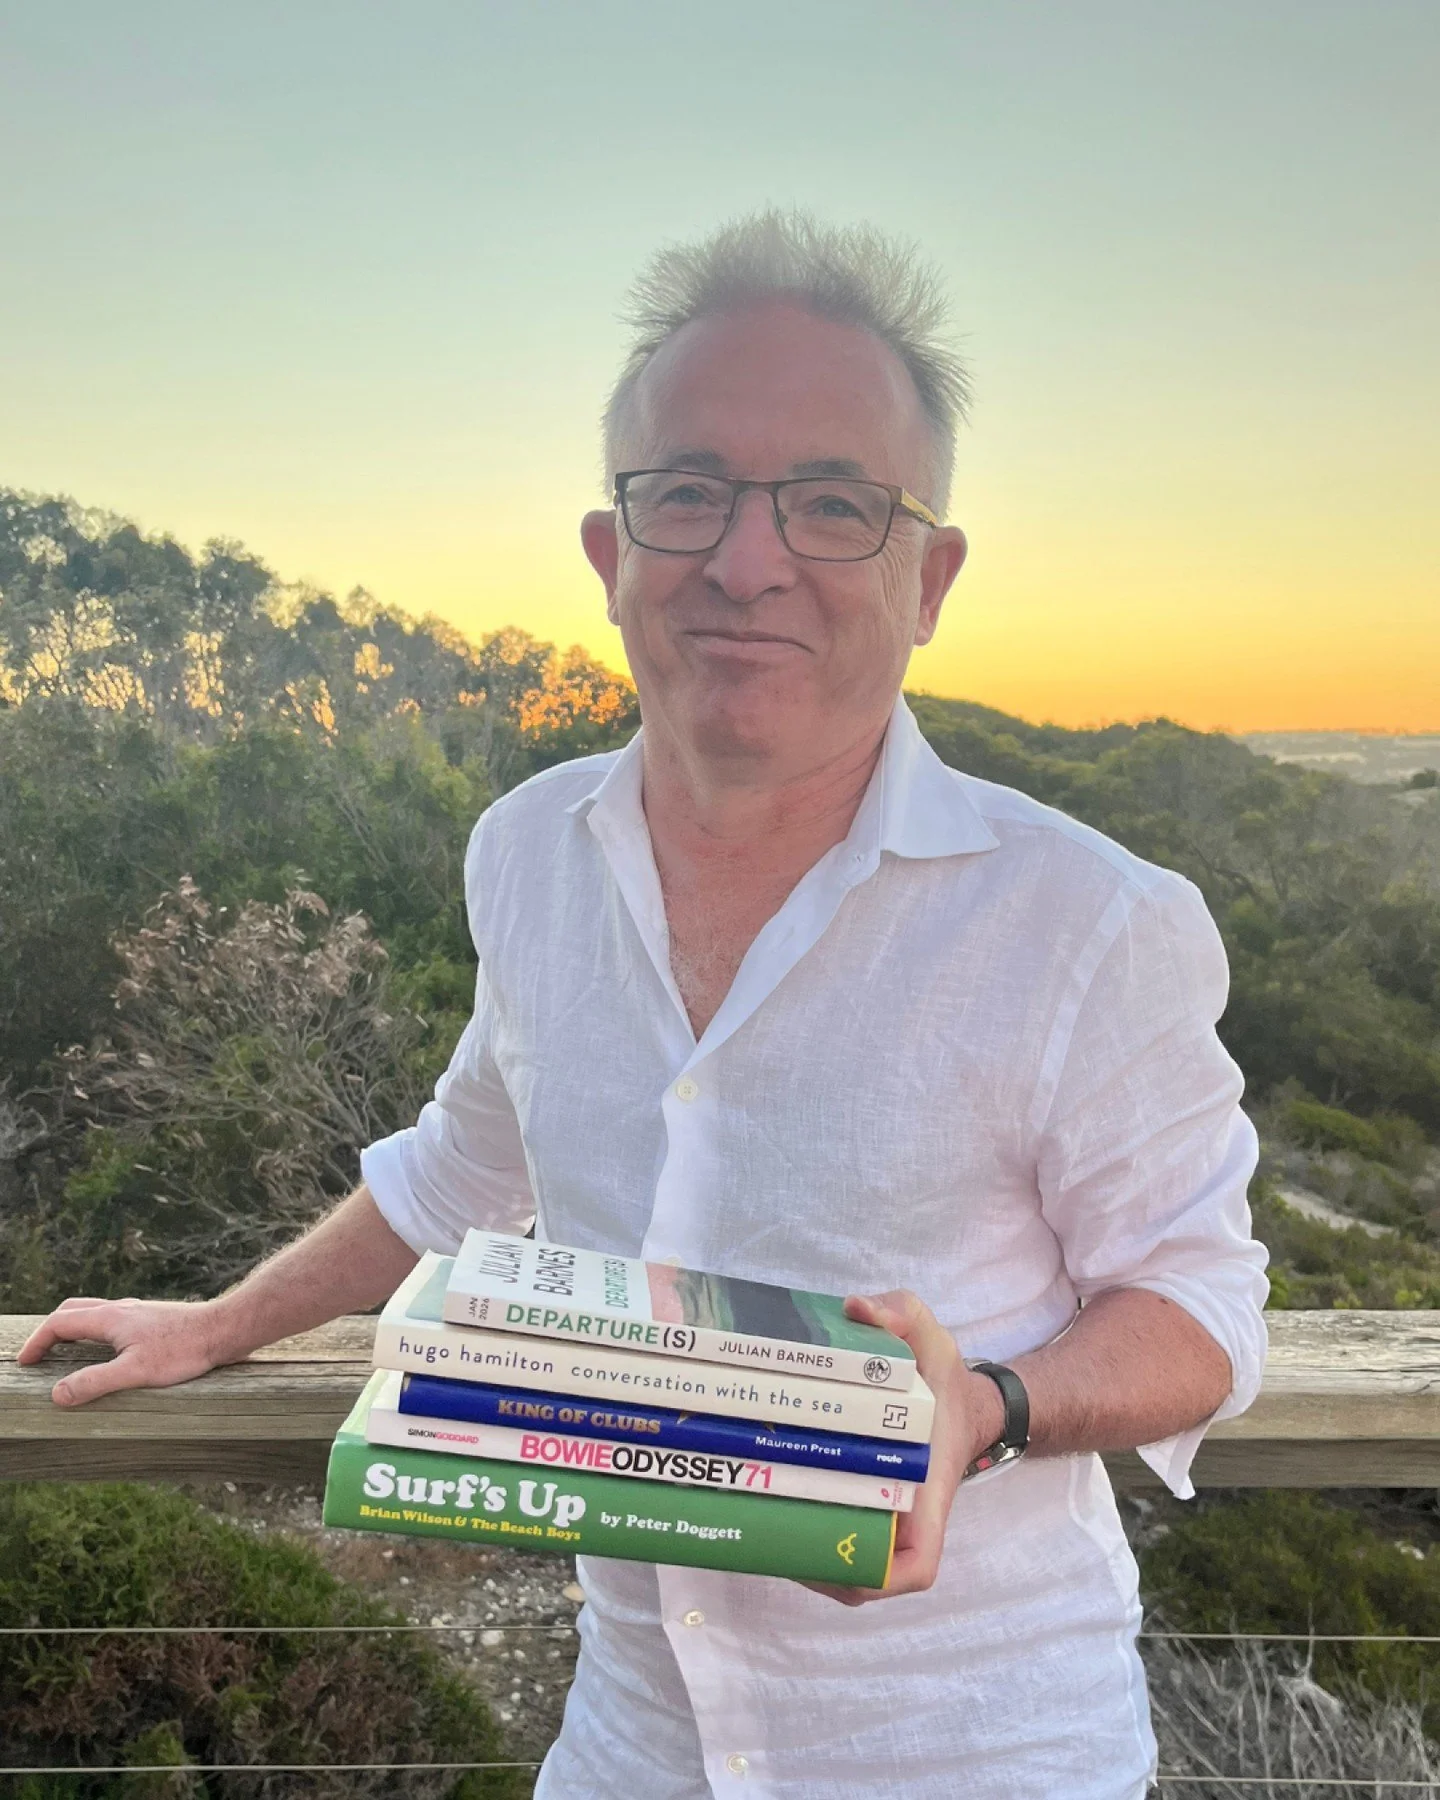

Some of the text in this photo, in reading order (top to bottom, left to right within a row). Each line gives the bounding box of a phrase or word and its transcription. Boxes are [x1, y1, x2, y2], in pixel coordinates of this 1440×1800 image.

[479, 1239, 525, 1284] JULIAN
[533, 1248, 577, 1297] BARNES
[468, 1296, 479, 1318] JAN
[479, 1297, 490, 1321] 2026
[506, 1303, 834, 1369] DEPARTURE(S) JULIAN BARNES
[399, 1336, 843, 1415] hugo hamilton conversation with the sea
[498, 1399, 903, 1465] KING OF CLUBS Maureen Prest route
[360, 1504, 581, 1541] Brian Wilson & The Beach Boys
[363, 1462, 742, 1541] Surf's Up by Peter Doggett
